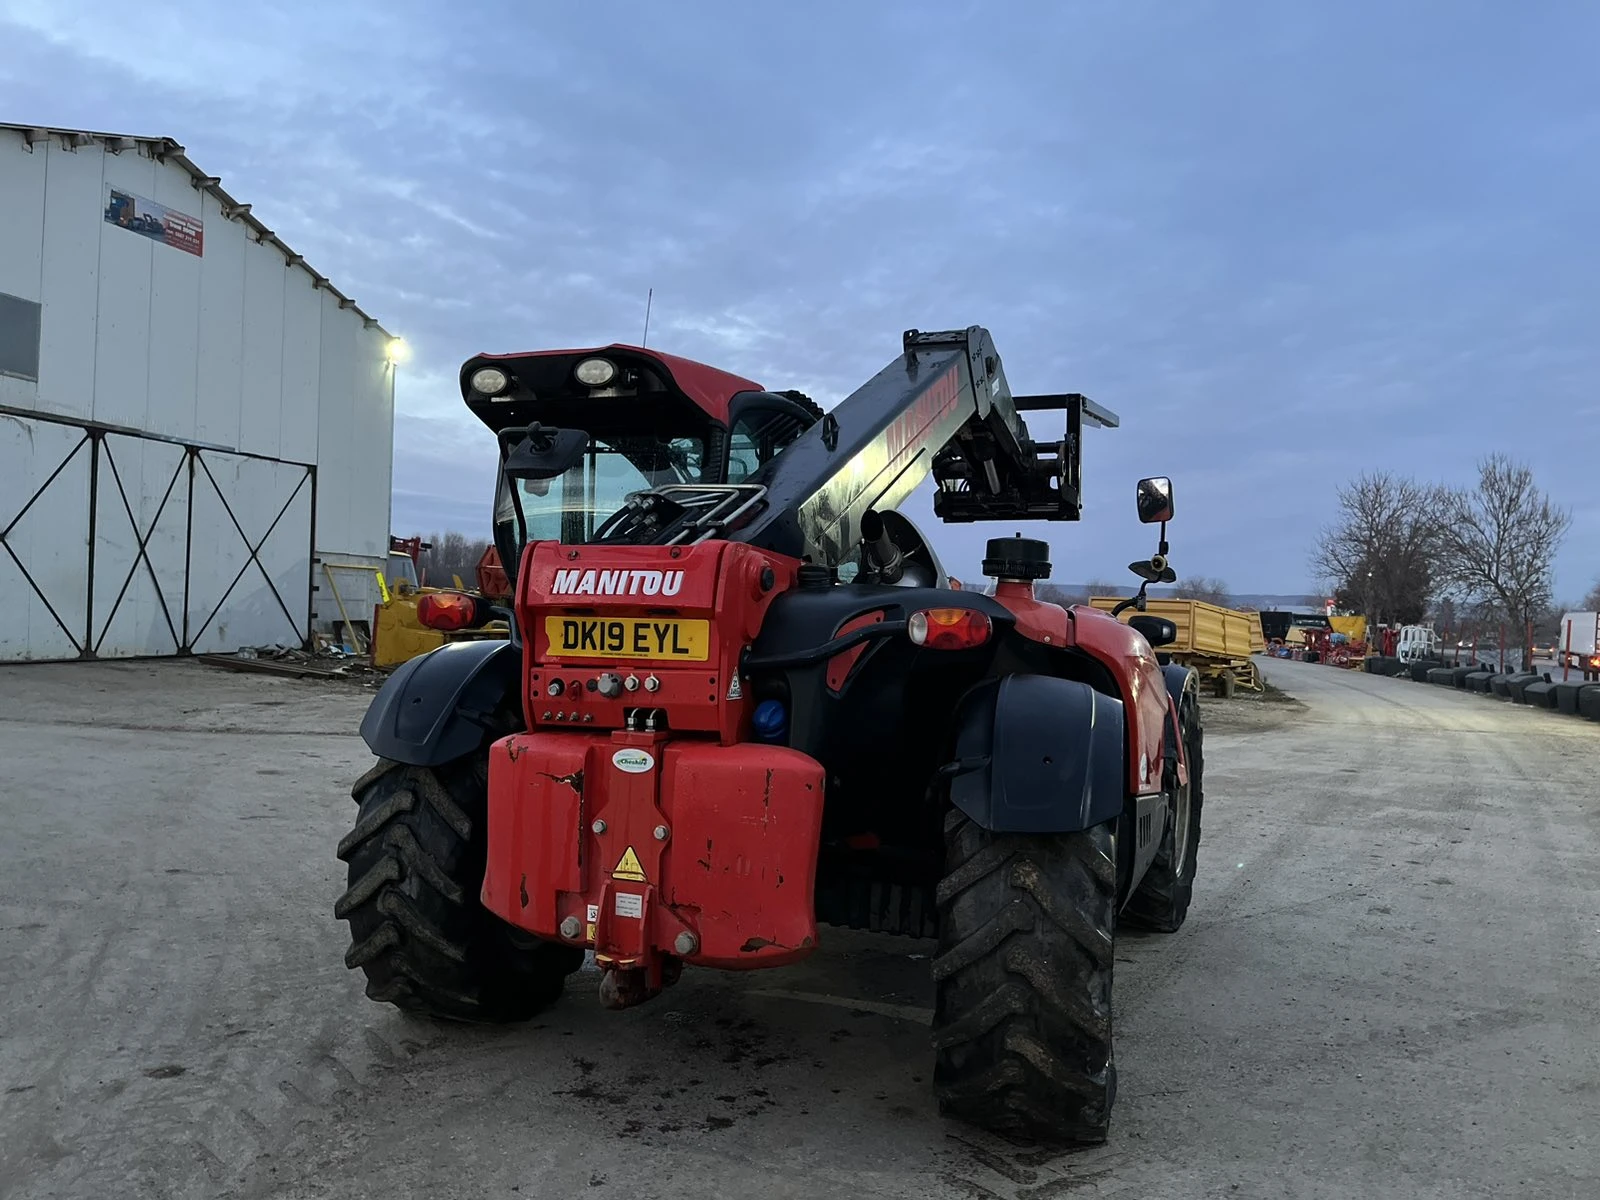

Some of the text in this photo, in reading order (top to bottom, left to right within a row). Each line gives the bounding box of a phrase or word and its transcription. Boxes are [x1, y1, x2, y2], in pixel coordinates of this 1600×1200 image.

[552, 570, 684, 596] MANITOU
[563, 621, 689, 654] DK19 EYL
